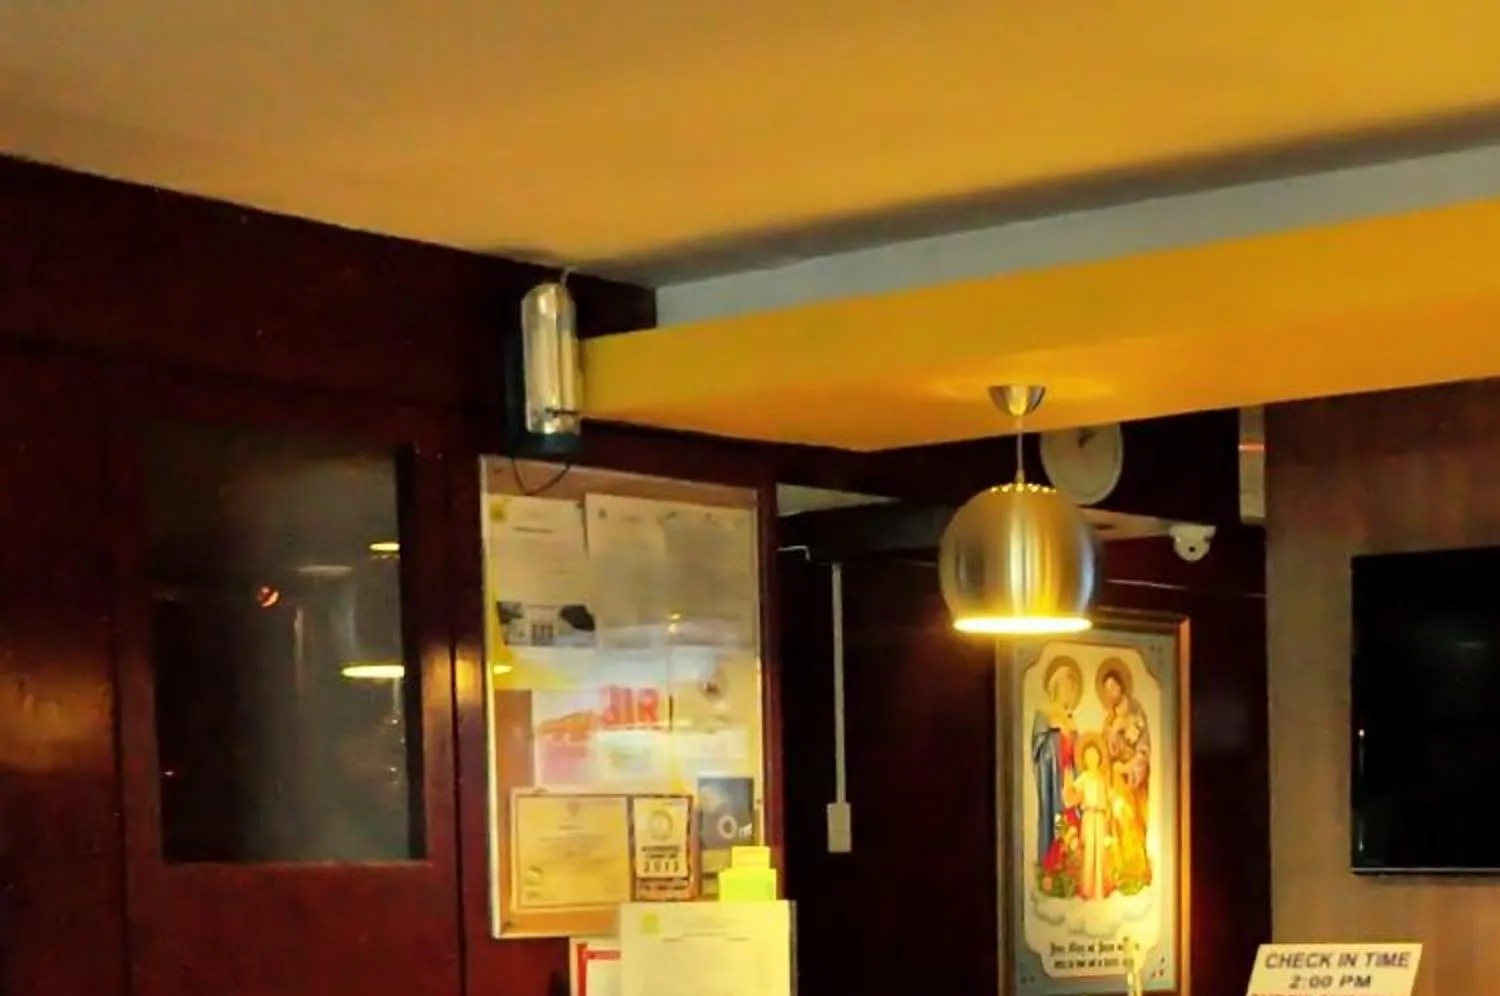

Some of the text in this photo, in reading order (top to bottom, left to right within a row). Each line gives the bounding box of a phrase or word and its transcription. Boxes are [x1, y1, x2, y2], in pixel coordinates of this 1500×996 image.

[1264, 951, 1410, 969] CHECK IN TIME
[1289, 974, 1372, 989] 2:00 PM
